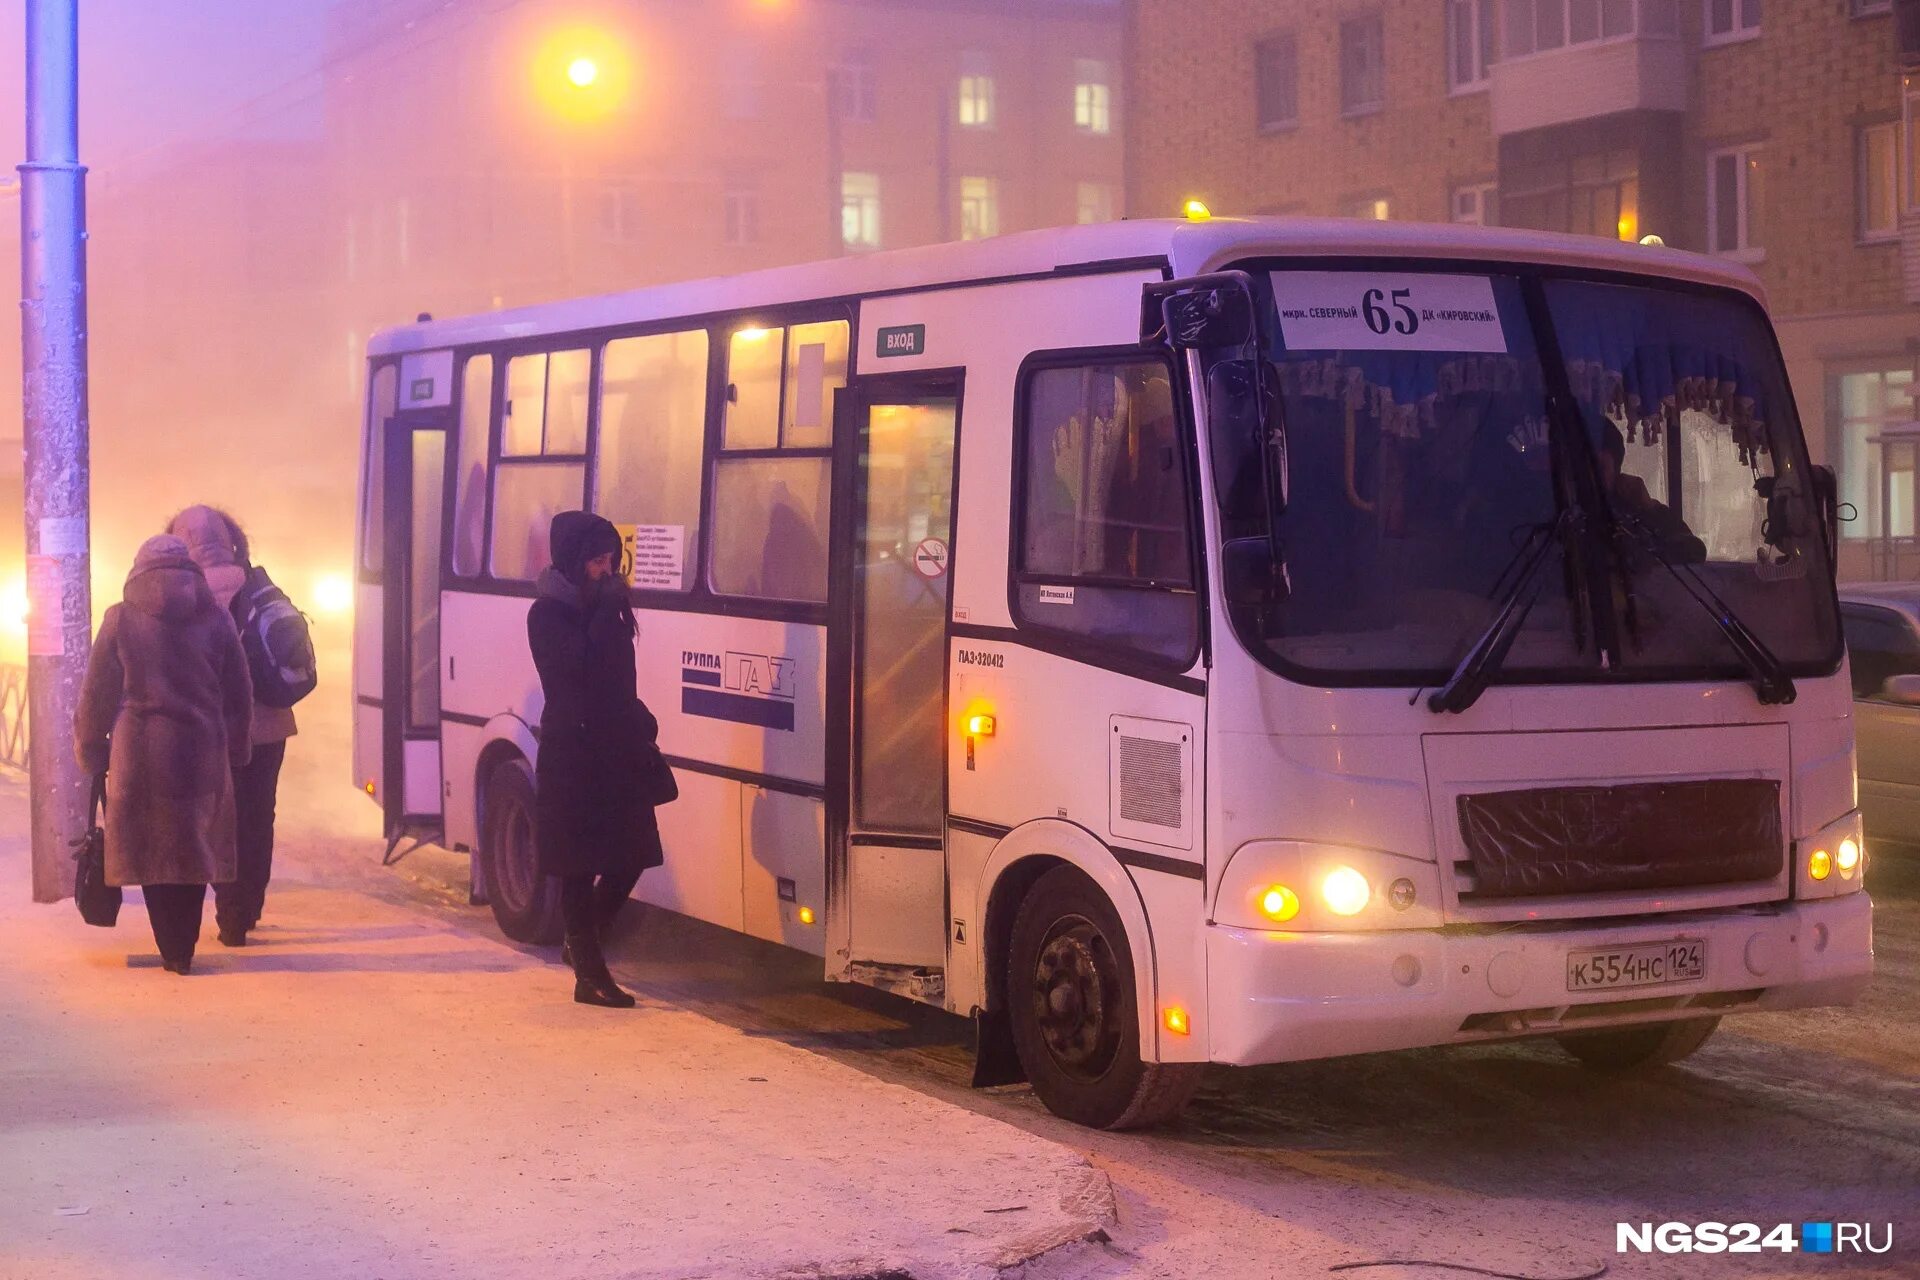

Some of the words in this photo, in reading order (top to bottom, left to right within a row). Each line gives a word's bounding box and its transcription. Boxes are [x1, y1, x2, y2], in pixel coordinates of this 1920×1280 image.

[1309, 306, 1358, 319] СЕВЕРНЫЙ
[1362, 288, 1419, 335] 65
[1422, 309, 1436, 321] ДК
[887, 332, 914, 351] ВХОД
[682, 651, 721, 669] ГРУППА
[725, 651, 796, 699] ГАЗ
[1575, 953, 1663, 986] К554НС
[1668, 946, 1699, 969] 124
[1674, 968, 1689, 977] RUS
